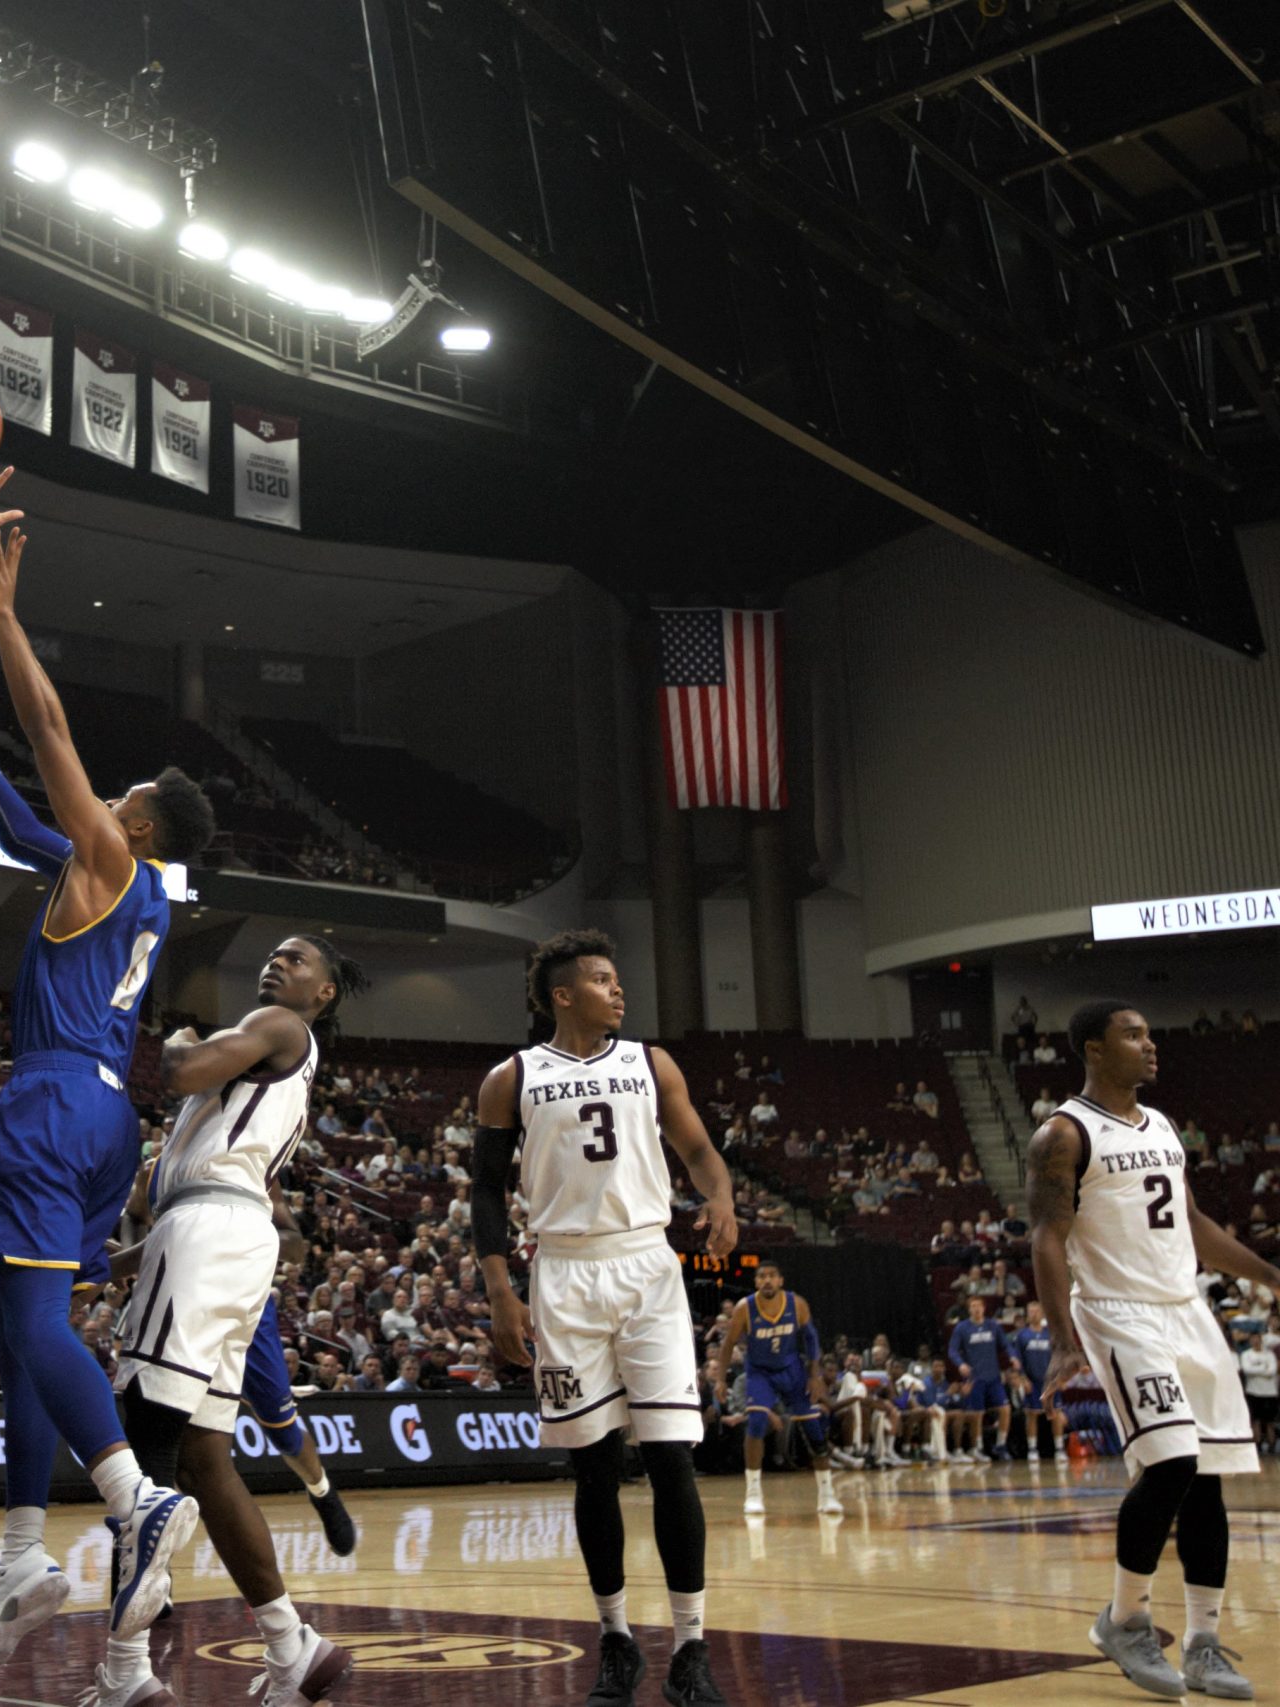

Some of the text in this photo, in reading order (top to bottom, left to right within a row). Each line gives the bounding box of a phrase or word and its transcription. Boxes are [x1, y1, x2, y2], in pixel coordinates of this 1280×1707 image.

[86, 397, 124, 433] 1922
[163, 427, 198, 461] 1921
[246, 469, 290, 498] 1920
[1138, 895, 1280, 930] WEDNESDA
[528, 1077, 650, 1106] TEXAS A&M
[578, 1101, 618, 1163] 3
[1101, 1150, 1162, 1174] TEXAS
[1143, 1174, 1175, 1229] 2
[771, 1337, 781, 1352] 2
[389, 1403, 433, 1462] G
[456, 1411, 541, 1450] GATO
